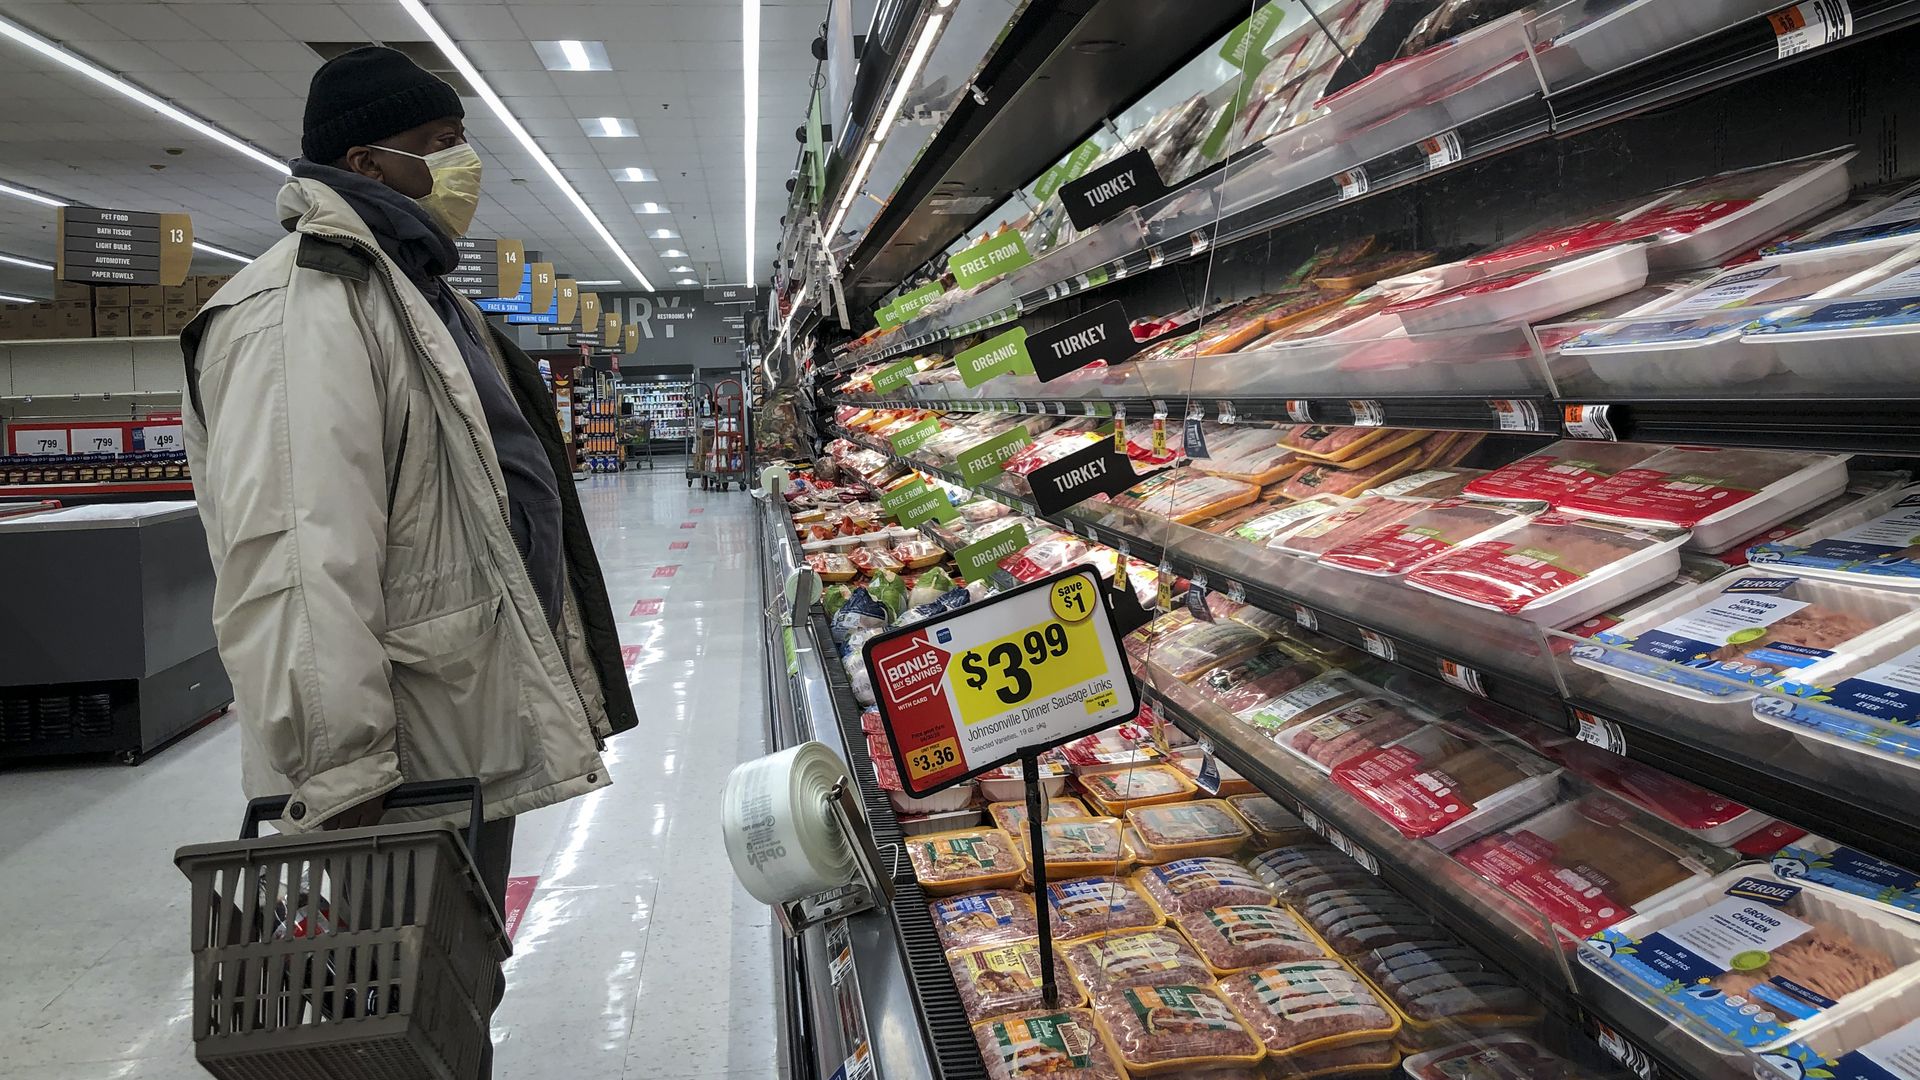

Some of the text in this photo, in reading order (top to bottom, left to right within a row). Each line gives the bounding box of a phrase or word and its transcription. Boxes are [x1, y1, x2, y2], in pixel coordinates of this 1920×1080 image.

[1084, 170, 1136, 207] TURKEY
[97, 227, 132, 236] BATH TISSUE
[170, 229, 184, 243] 13
[113, 243, 132, 251] BULBS
[96, 256, 130, 265] AUTOMOTIVE
[505, 252, 517, 264] 14
[960, 242, 1020, 278] FREE FROM
[112, 272, 134, 280] TOWELS
[538, 273, 548, 284] 15
[563, 288, 572, 298] 16
[723, 290, 737, 298] EGGS
[900, 290, 941, 314] FREE FROM
[586, 301, 594, 310] 17
[610, 320, 617, 328] 18
[1051, 324, 1107, 360] TURKEY
[972, 343, 1018, 372] ORGANIC
[878, 365, 914, 388] FREE FROM
[38, 439, 58, 452] $799
[93, 438, 113, 450] $799
[154, 435, 174, 448] $499
[898, 425, 937, 448] FREE FROM
[968, 438, 1026, 474] FREE FROM
[1053, 457, 1107, 493] TURKEY
[887, 486, 924, 509] FREE FROM
[908, 498, 940, 520] ORGANIC
[972, 539, 1017, 568] ORGANIC
[1058, 580, 1083, 597] save
[1735, 580, 1787, 588] PERDUE
[1063, 592, 1086, 614] $1
[1728, 604, 1767, 615] CHICKEN
[1739, 598, 1778, 609] GROUND
[887, 650, 939, 683] BONUS
[961, 623, 1069, 705] $399
[892, 664, 943, 690] BUY SAVINGS
[898, 696, 928, 712] WITH CARD
[1852, 692, 1907, 709] ANTIBIOTICS
[968, 679, 1113, 742] Johnsonville Dinner Sausage Links
[970, 741, 994, 754] Selected
[912, 746, 954, 770] $3.36
[1850, 860, 1900, 878] ANTIBIOTICS
[1738, 880, 1794, 898] PERDUE
[1732, 912, 1770, 934] CHICKEN
[1743, 907, 1782, 928] GROUND
[1654, 949, 1691, 972] ANTIBIOTICS
[1676, 952, 1688, 960] NO
